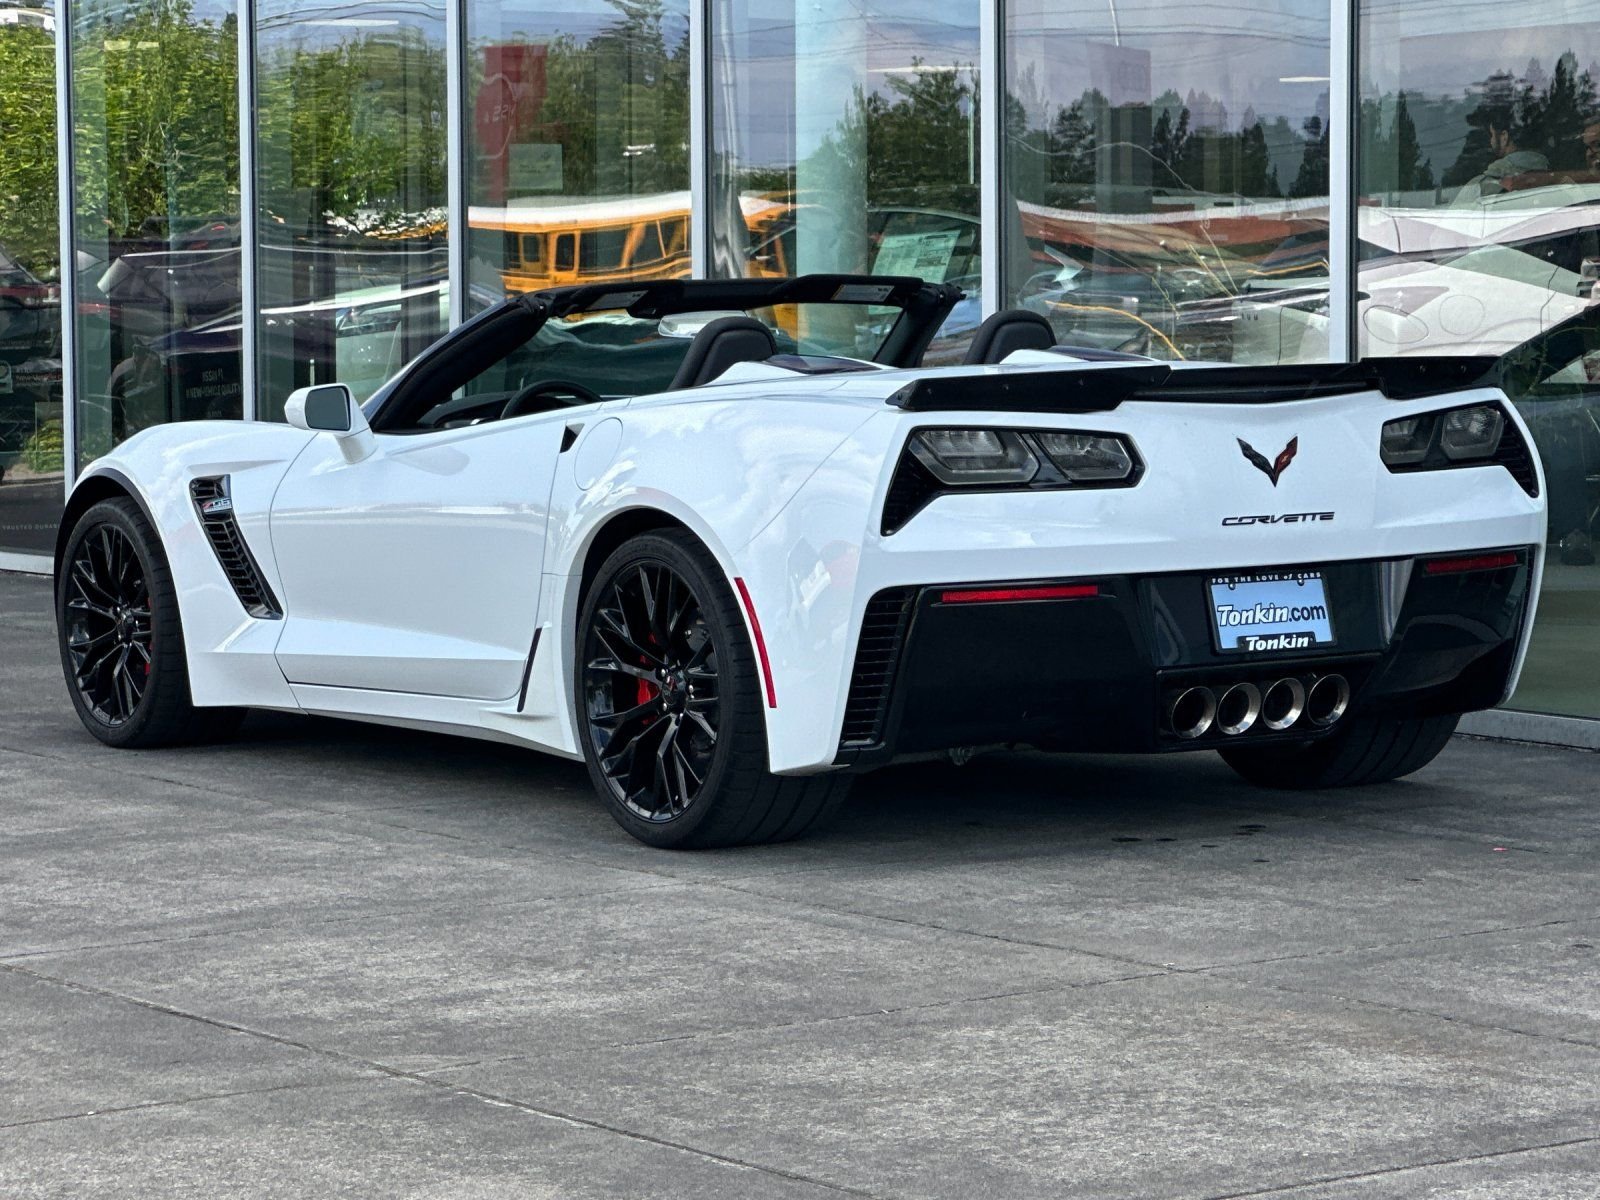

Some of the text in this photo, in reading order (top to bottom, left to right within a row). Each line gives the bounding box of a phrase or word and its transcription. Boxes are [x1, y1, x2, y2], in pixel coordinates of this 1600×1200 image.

[1222, 511, 1335, 526] CORVETTE
[1216, 602, 1327, 627] Tonkin.com
[1246, 634, 1309, 651] Tonkin
